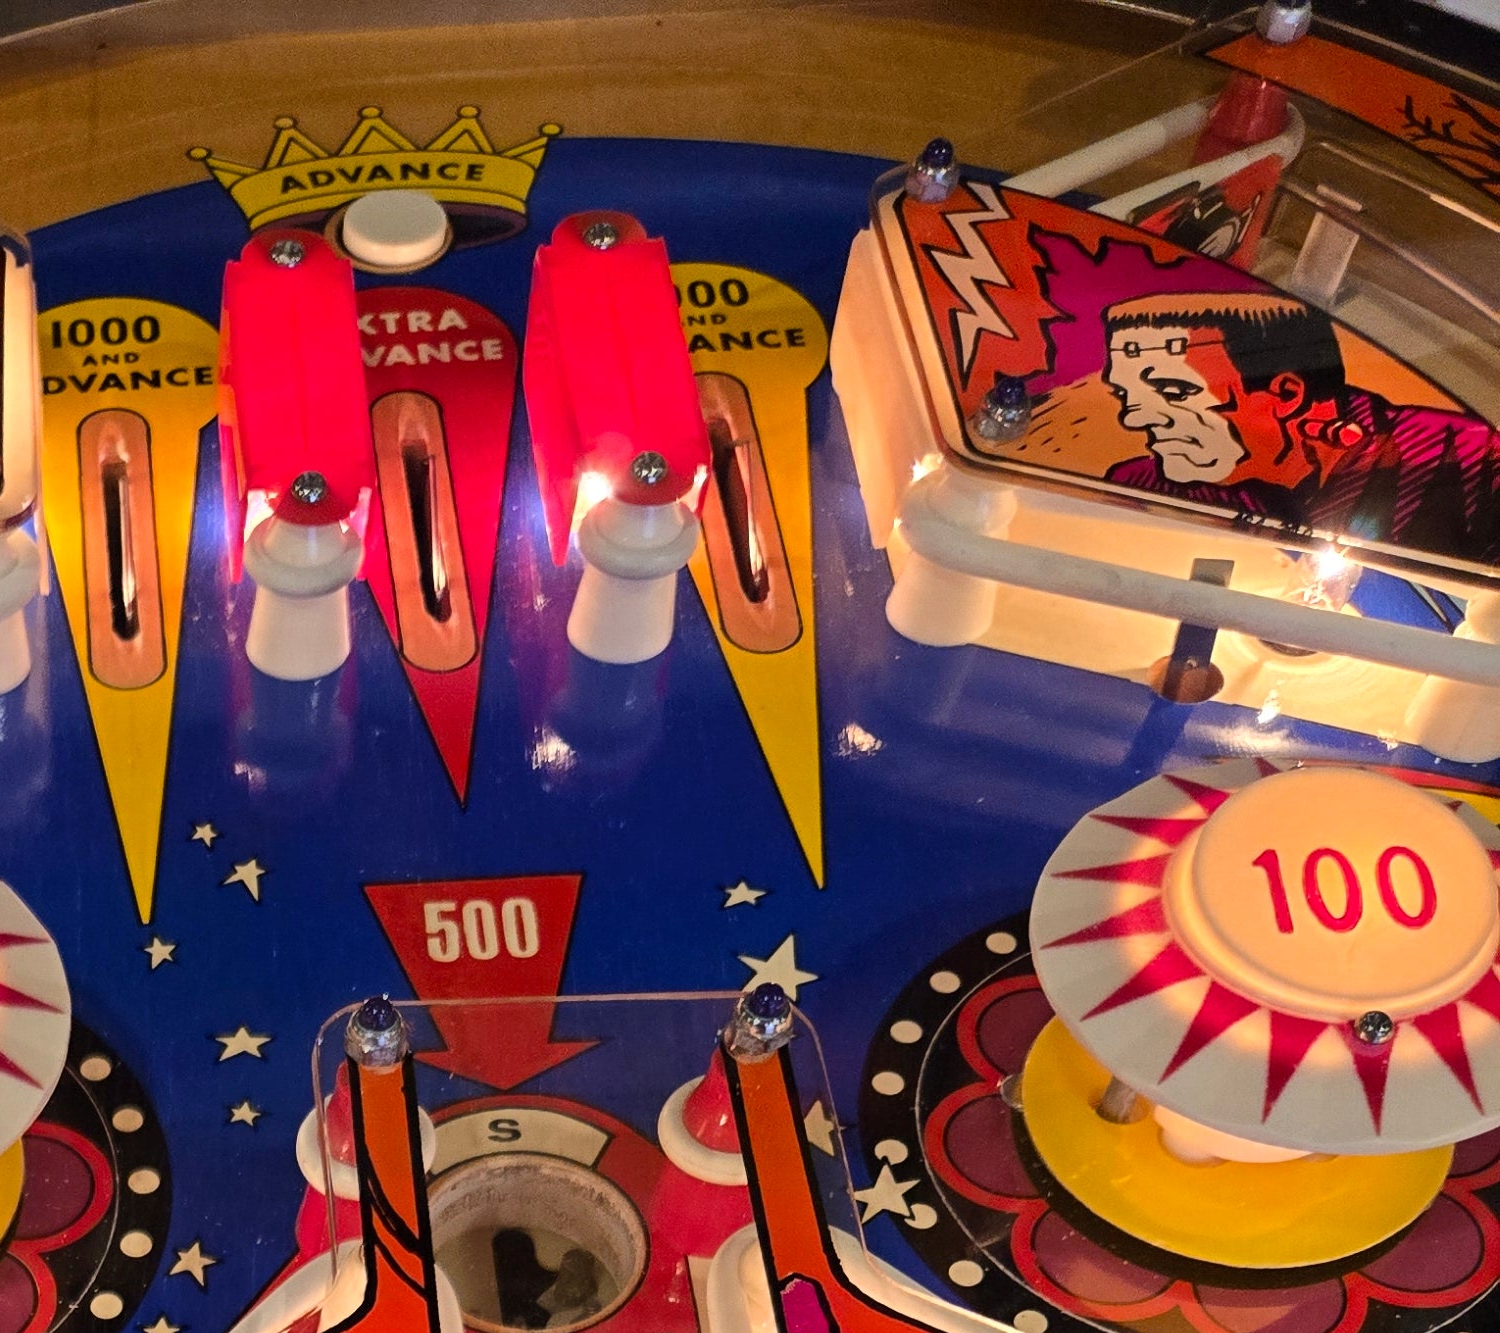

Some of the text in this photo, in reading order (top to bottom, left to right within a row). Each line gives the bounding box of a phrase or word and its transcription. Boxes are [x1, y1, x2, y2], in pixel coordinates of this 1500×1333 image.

[280, 162, 486, 194] ADVANCE
[674, 277, 750, 309] 00
[51, 315, 161, 349] 1000
[357, 307, 468, 336] XTRA
[682, 313, 727, 327] ND
[360, 338, 504, 368] VANCE
[688, 328, 806, 354] ANCE
[81, 352, 140, 368] AND
[42, 366, 214, 396] DVANCE
[1251, 845, 1438, 934] 100
[423, 897, 539, 963] 500
[487, 1118, 522, 1142] S
